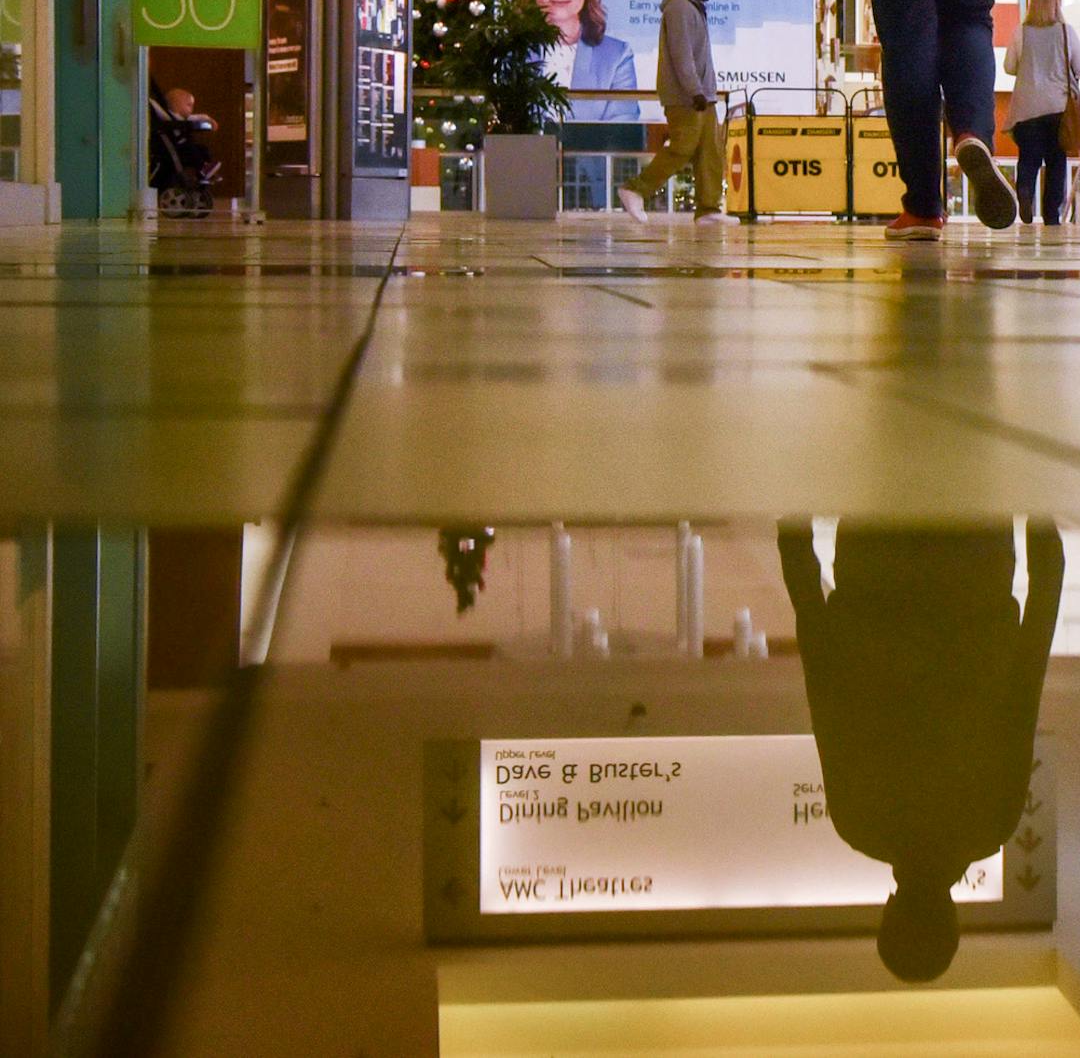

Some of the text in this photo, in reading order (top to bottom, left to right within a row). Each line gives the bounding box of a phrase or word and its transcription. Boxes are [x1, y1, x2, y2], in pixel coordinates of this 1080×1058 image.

[717, 71, 786, 83] SMUSSEN
[773, 160, 822, 176] OTIS
[872, 161, 900, 178] OT
